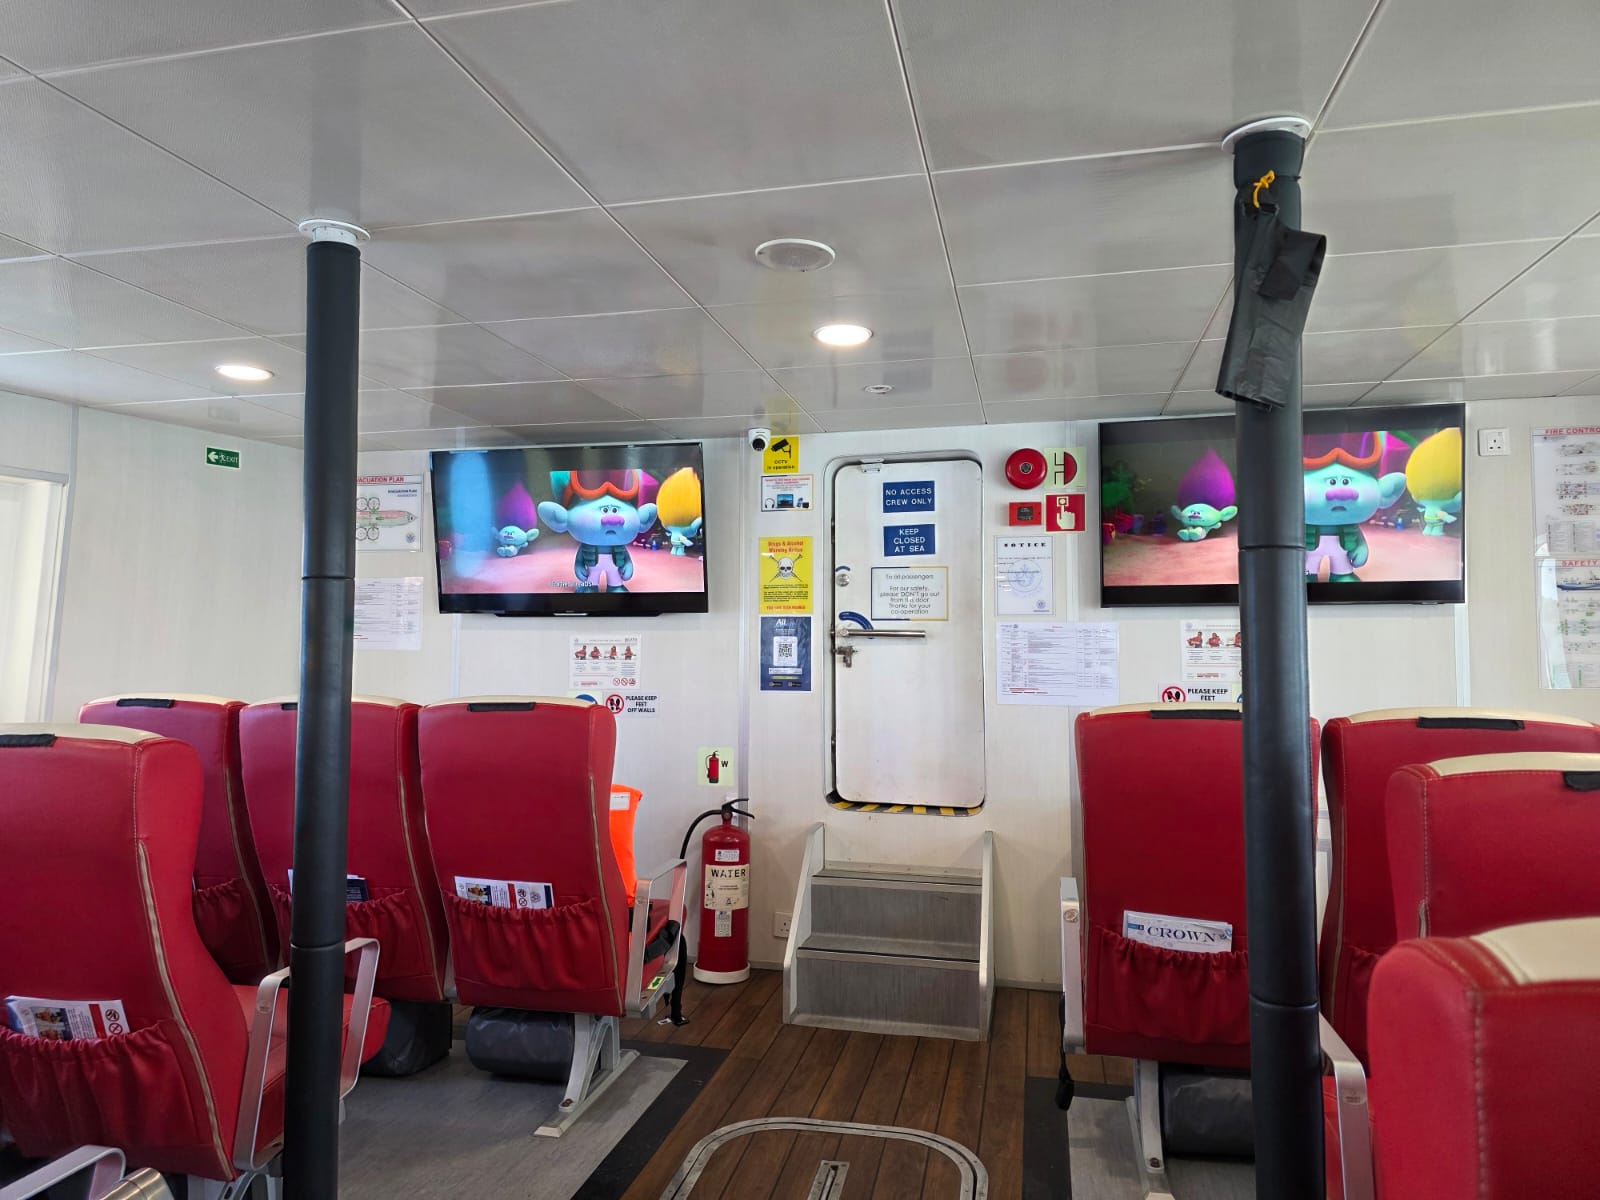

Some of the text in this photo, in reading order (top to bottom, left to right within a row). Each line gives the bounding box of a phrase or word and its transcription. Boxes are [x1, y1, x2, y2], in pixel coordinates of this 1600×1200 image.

[893, 536, 925, 545] CLOSED
[721, 760, 729, 768] W
[711, 869, 746, 878] WATER
[1147, 926, 1216, 943] CROWN
